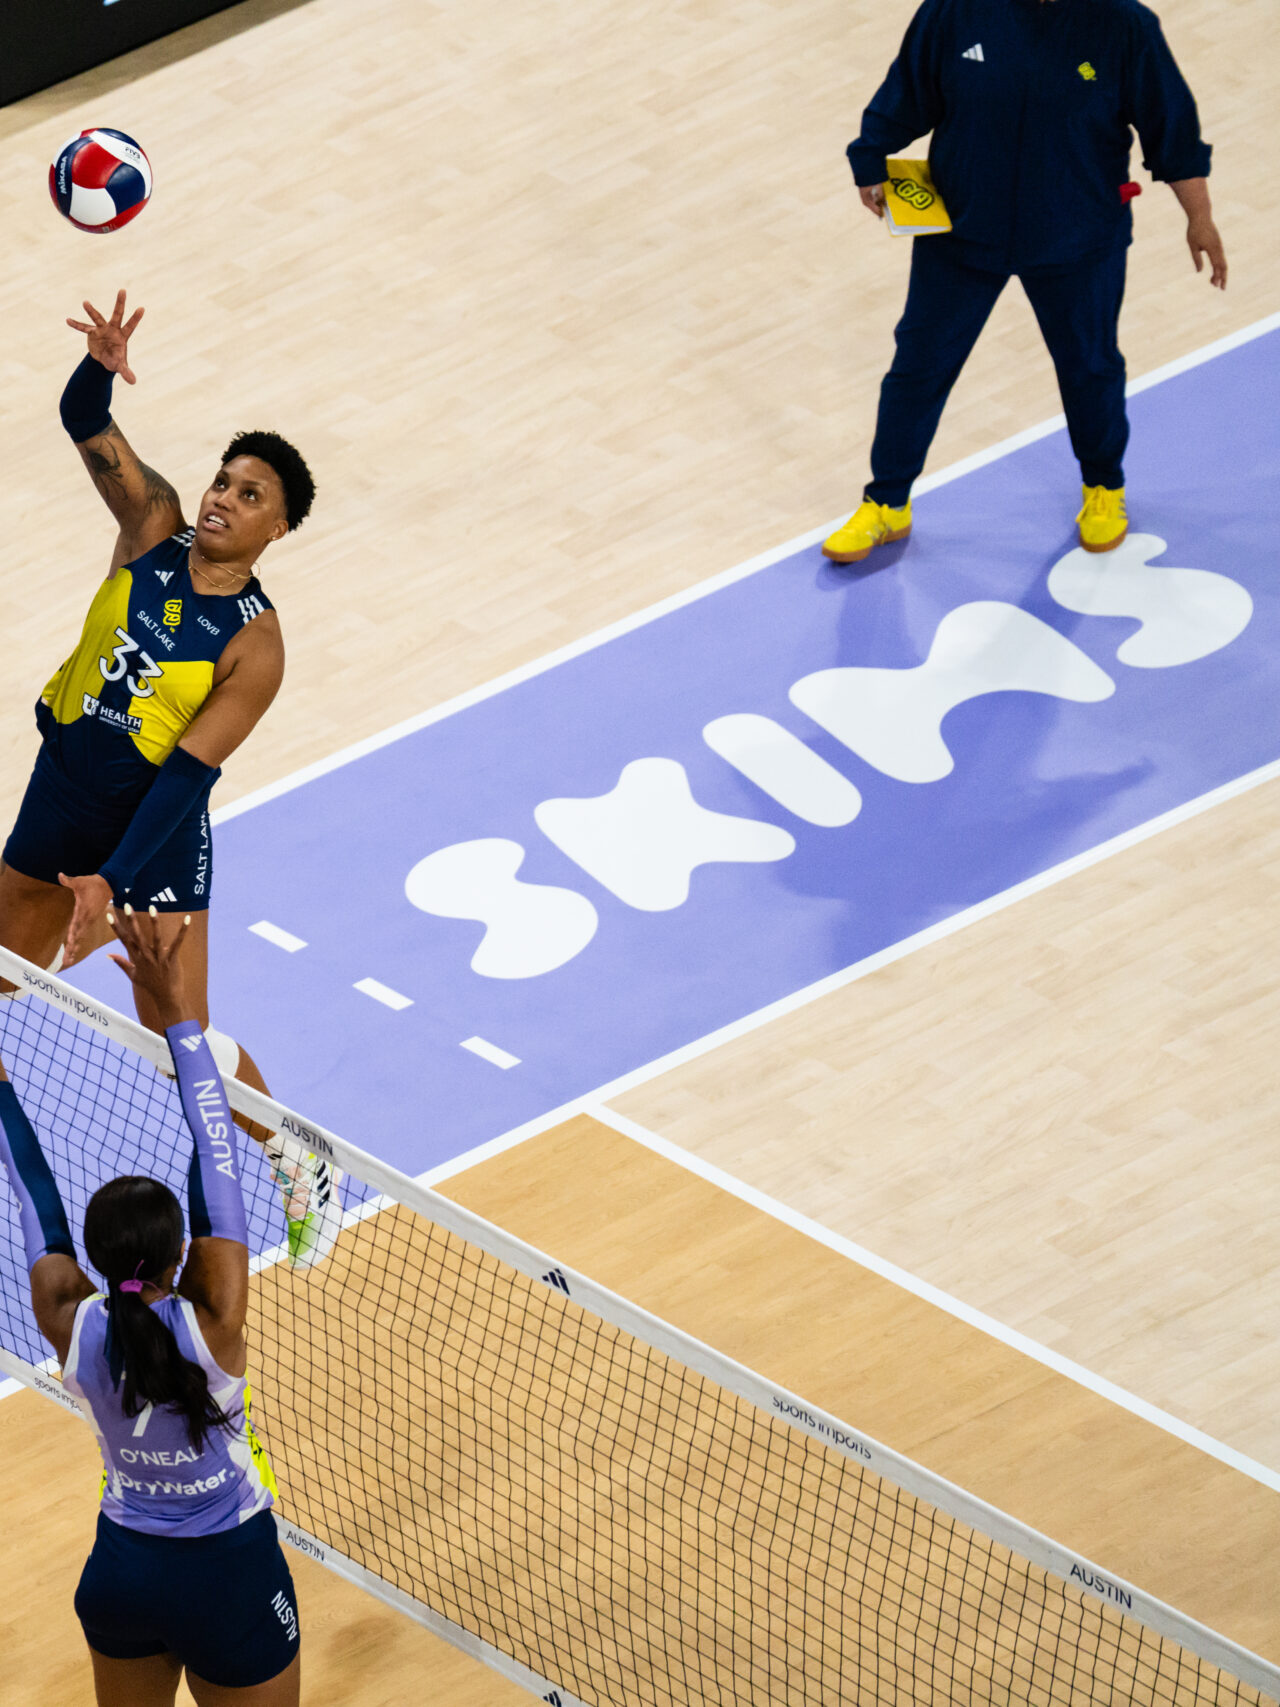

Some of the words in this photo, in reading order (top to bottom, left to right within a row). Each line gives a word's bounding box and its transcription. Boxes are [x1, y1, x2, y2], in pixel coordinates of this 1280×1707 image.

[137, 610, 158, 630] SALT
[154, 628, 175, 652] LAKE
[197, 615, 220, 636] LOVB
[99, 626, 164, 698] 33
[100, 705, 142, 728] HEALTH
[405, 532, 1254, 979] SKIMS
[194, 852, 208, 895] SALT
[23, 971, 60, 998] sports
[193, 1079, 237, 1180] AUSTIN
[281, 1116, 334, 1156] AUSTIN
[772, 1396, 816, 1428] sports
[286, 1530, 325, 1562] AUSTIN
[1070, 1562, 1132, 1610] AUSTIN
